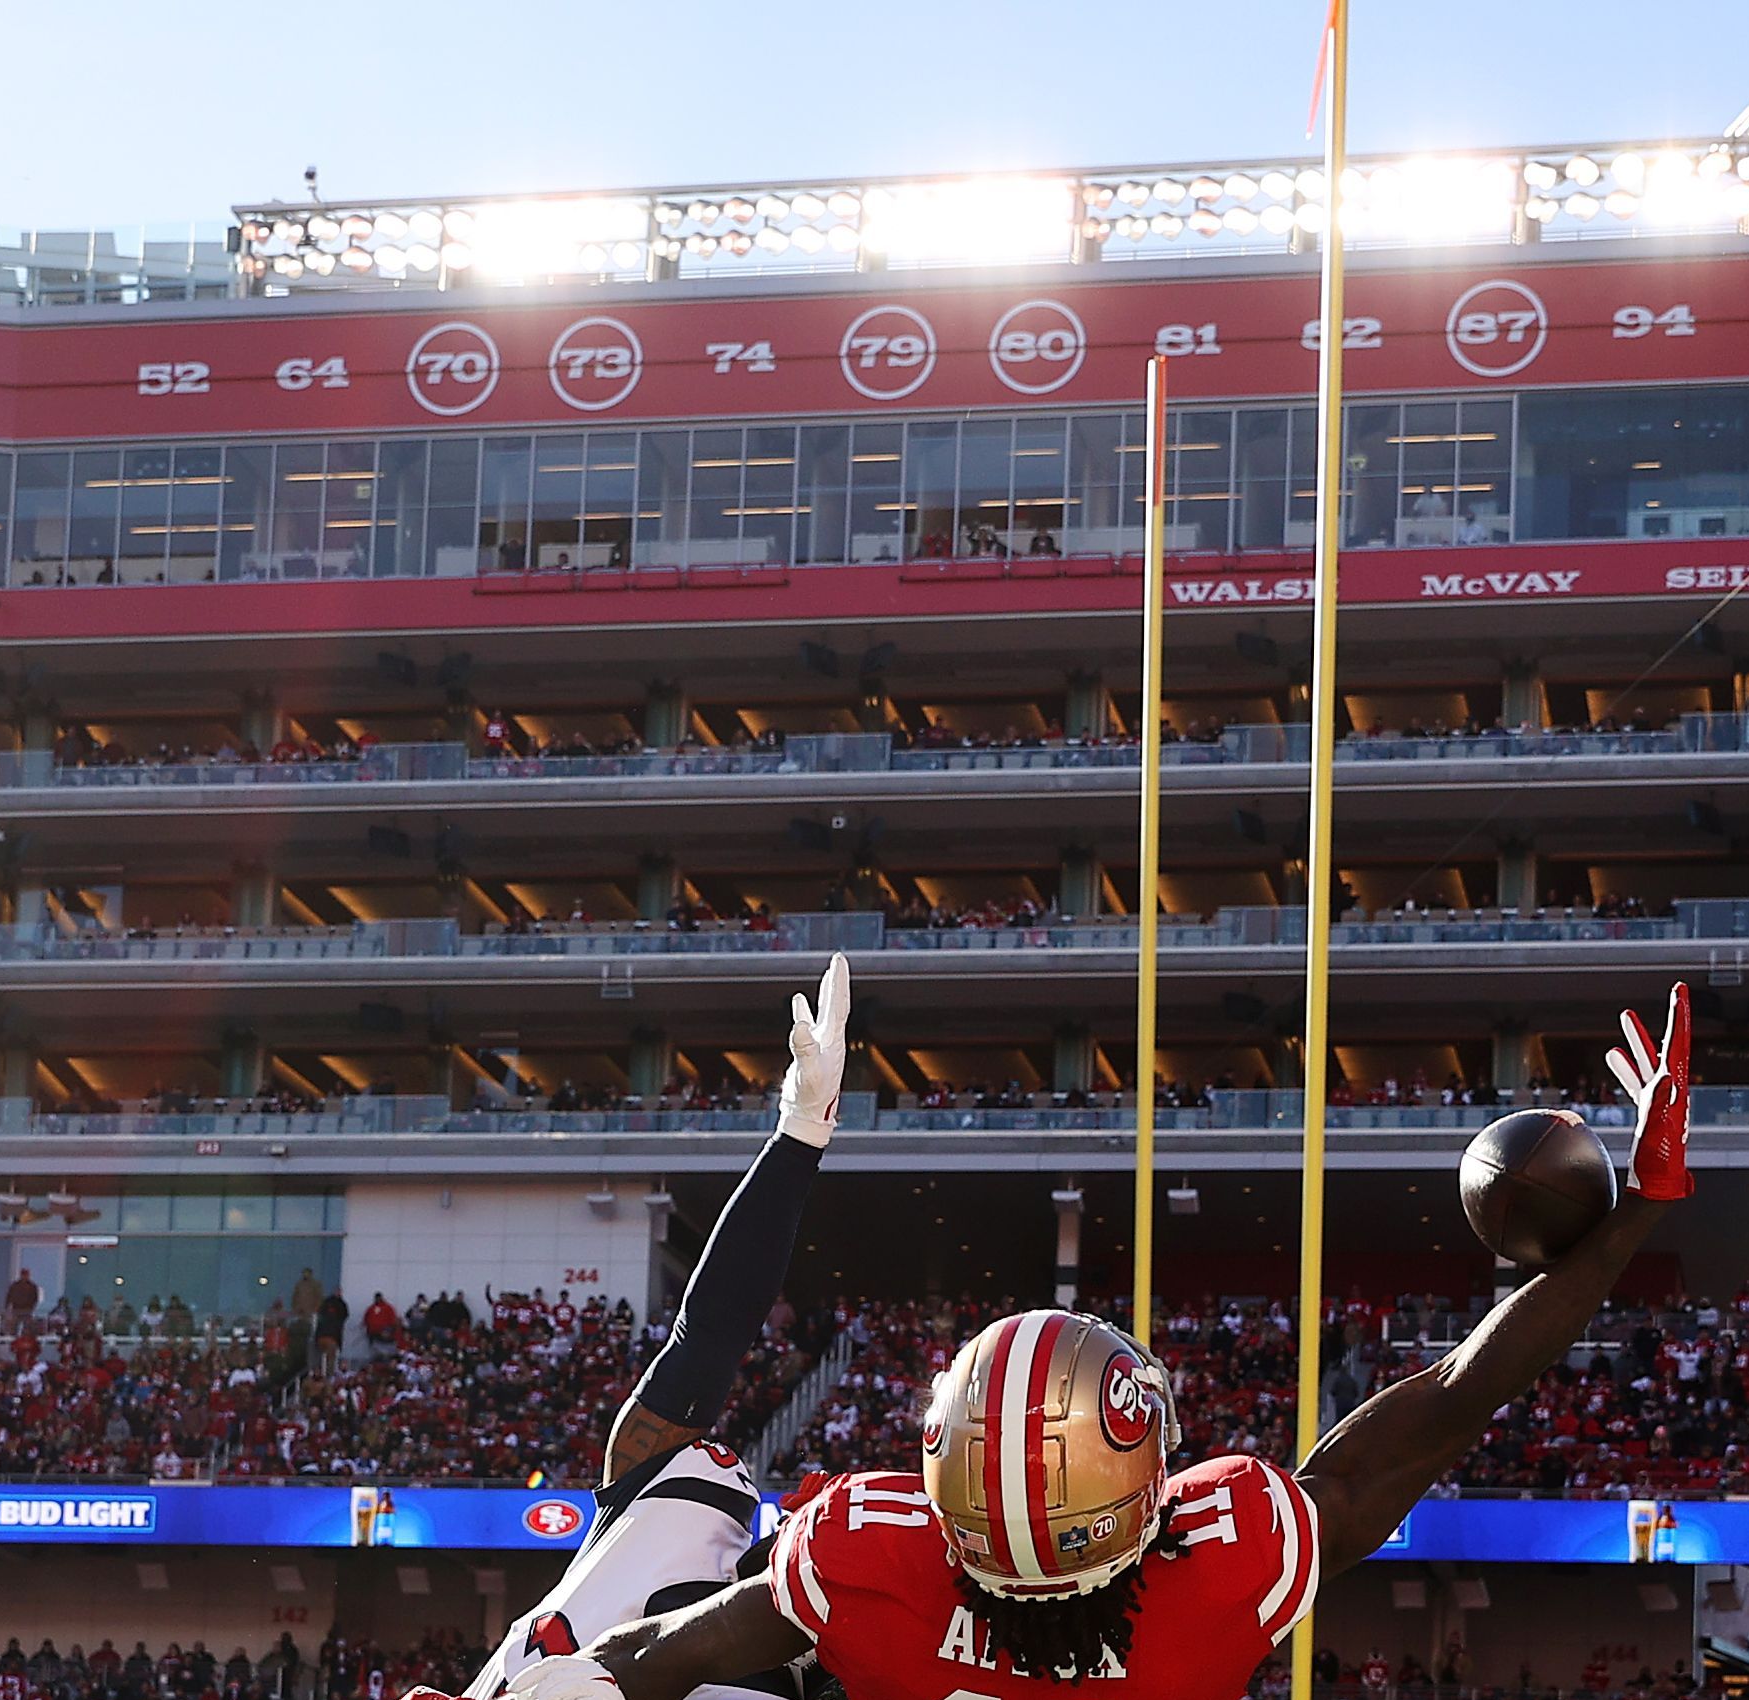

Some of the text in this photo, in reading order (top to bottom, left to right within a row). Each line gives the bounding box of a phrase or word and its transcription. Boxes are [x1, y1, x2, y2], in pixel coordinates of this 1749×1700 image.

[1457, 310, 1536, 345] 87
[1612, 306, 1697, 340] 94
[850, 334, 927, 369] 79
[998, 329, 1078, 363] 80
[1155, 324, 1221, 357] 81
[274, 356, 350, 390] 64
[418, 350, 489, 383] 70
[559, 346, 634, 379] 73
[706, 341, 777, 374] 74
[139, 362, 211, 394] 52
[1420, 570, 1581, 598] McVAY
[564, 1268, 599, 1284] 244
[63, 1501, 149, 1528] LIGHT
[849, 1484, 931, 1530] 11
[1095, 1518, 1113, 1537] 70
[272, 1607, 308, 1623] 142
